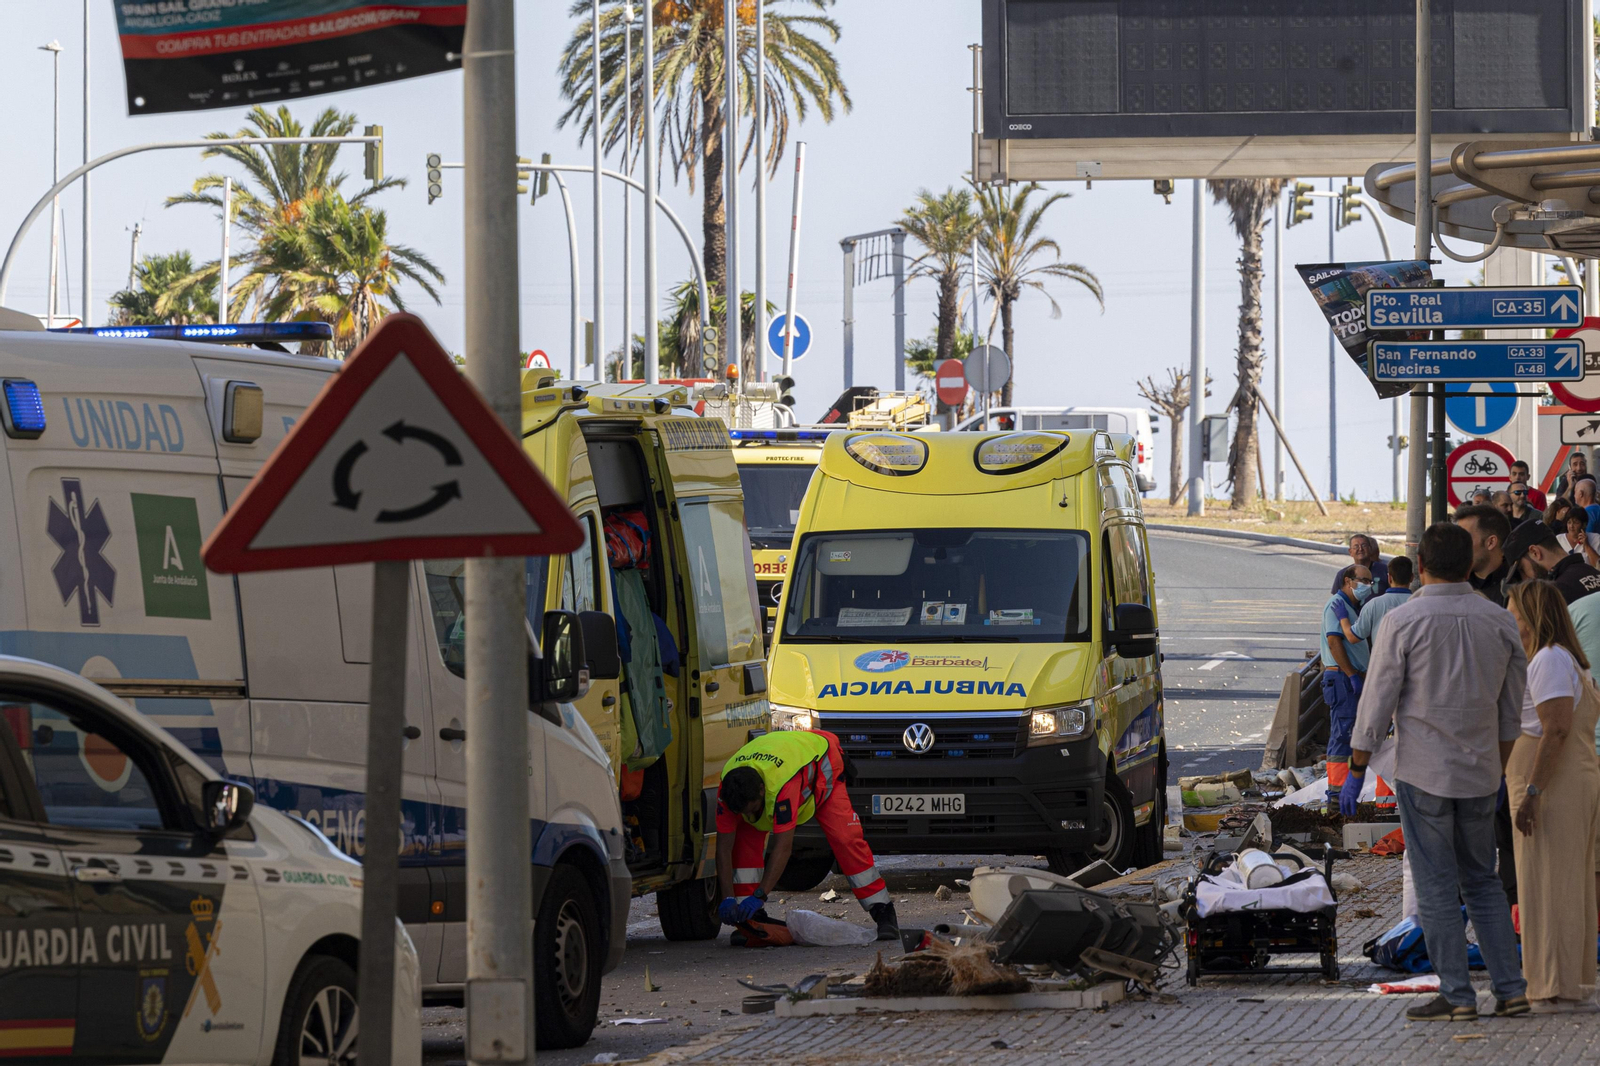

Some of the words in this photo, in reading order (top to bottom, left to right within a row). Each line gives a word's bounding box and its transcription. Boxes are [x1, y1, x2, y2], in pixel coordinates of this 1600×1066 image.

[157, 1, 188, 13] SAIL
[156, 35, 212, 54] COMPRA
[214, 33, 239, 48] TUS
[238, 23, 308, 46] ENTRADAS
[1373, 294, 1401, 306] Pto.
[1410, 293, 1442, 306] Real
[1496, 301, 1542, 314] CA-35
[1373, 307, 1444, 324] Sevilla
[1377, 348, 1401, 360] San
[1409, 348, 1477, 360] Fernando
[1510, 348, 1544, 357] CA-33
[1378, 362, 1441, 377] Algeciras
[1517, 364, 1544, 373] A-48
[62, 397, 185, 452] UNIDAD
[911, 658, 982, 666] Barbate
[884, 796, 925, 812] 0242
[931, 797, 962, 812] MHG
[282, 870, 327, 885] GUARDIA
[326, 873, 350, 888] CIVIL
[106, 923, 173, 963] CIVIL
